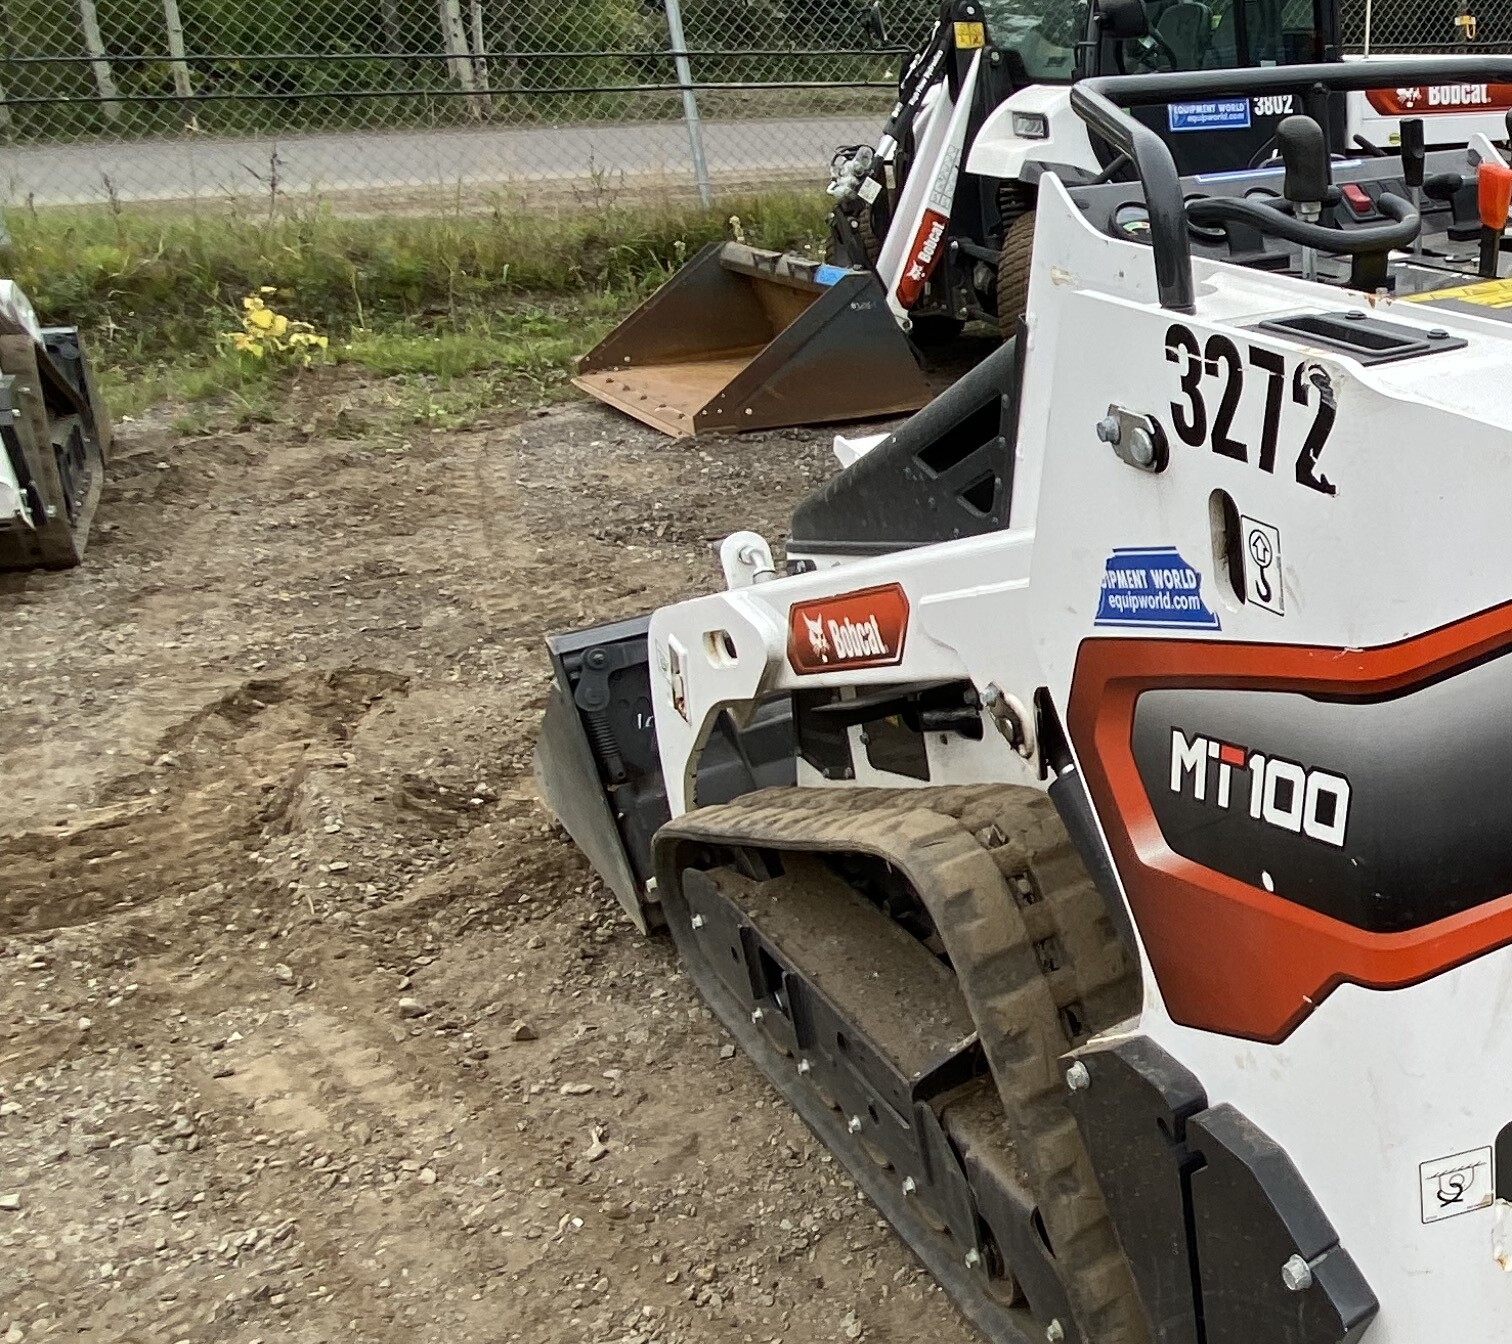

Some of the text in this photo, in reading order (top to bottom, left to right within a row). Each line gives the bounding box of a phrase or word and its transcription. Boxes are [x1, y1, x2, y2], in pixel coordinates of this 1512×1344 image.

[1253, 94, 1293, 116] 3802
[1428, 83, 1488, 105] Bobcat
[917, 221, 946, 264] Bobcat
[1165, 323, 1336, 496] 3272
[1150, 568, 1198, 589] WORLD
[1108, 590, 1201, 613] equipworld.com
[827, 614, 886, 659] Bobcat
[1170, 730, 1350, 847] MT100
